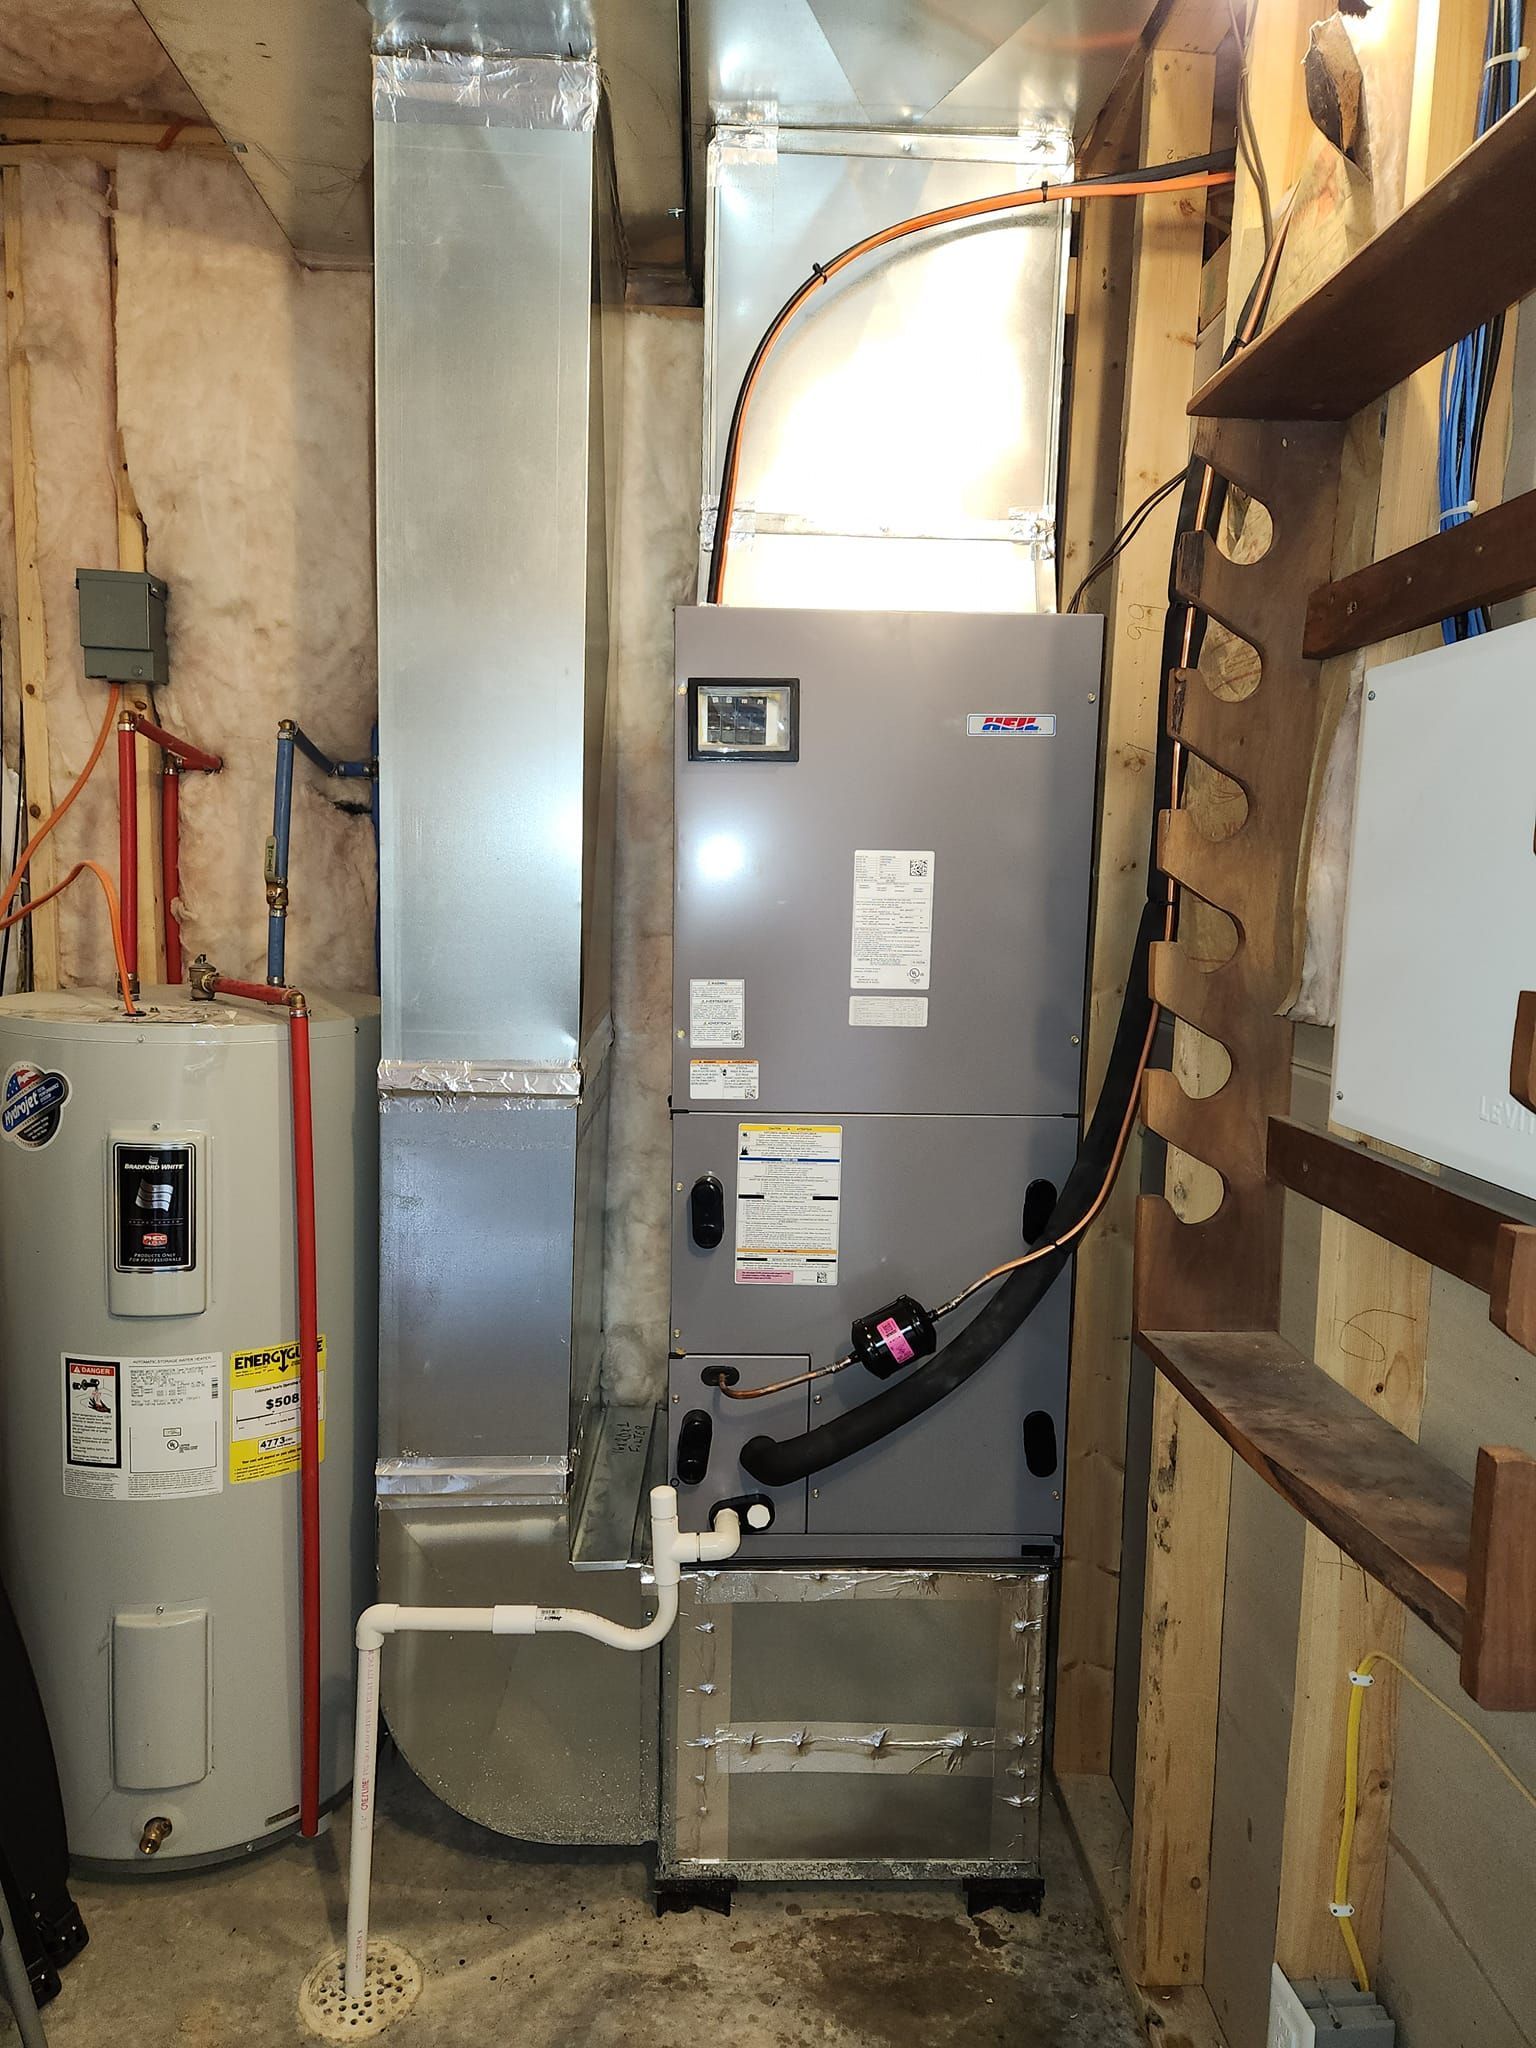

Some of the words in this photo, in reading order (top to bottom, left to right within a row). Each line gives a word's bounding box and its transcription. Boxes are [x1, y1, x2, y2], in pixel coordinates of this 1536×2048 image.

[981, 717, 1041, 731] HEIL
[4, 1090, 39, 1127] Hydrojet
[81, 1367, 112, 1375] DANGER
[266, 1393, 299, 1409] $508
[260, 1436, 285, 1448] 4773
